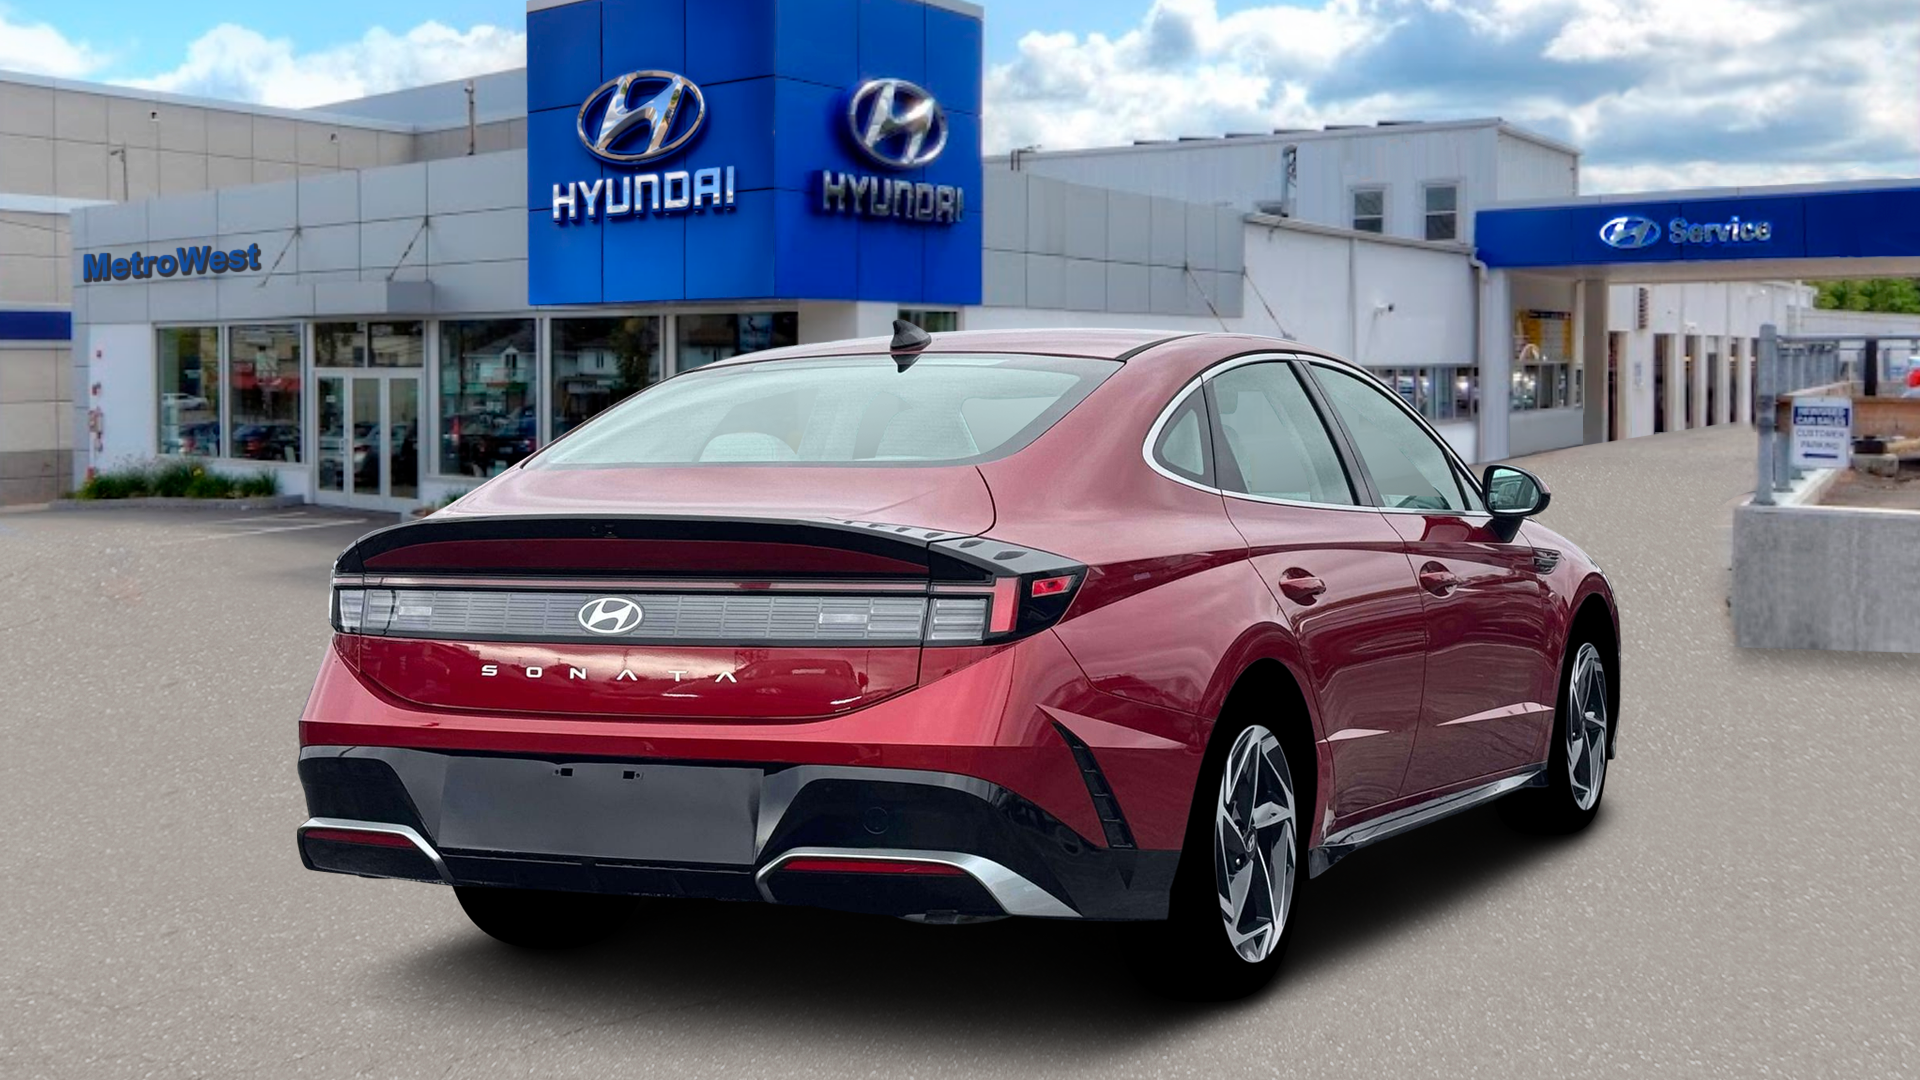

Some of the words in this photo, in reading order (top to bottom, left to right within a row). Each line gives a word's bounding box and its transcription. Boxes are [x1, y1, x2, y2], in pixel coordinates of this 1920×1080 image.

[552, 166, 735, 221] HYUNDAI
[822, 169, 964, 223] HYUNDAI
[1669, 215, 1772, 244] Service
[83, 243, 262, 283] MetroWest
[1796, 428, 1844, 438] CUSTOMER
[481, 664, 738, 683] SONATA
